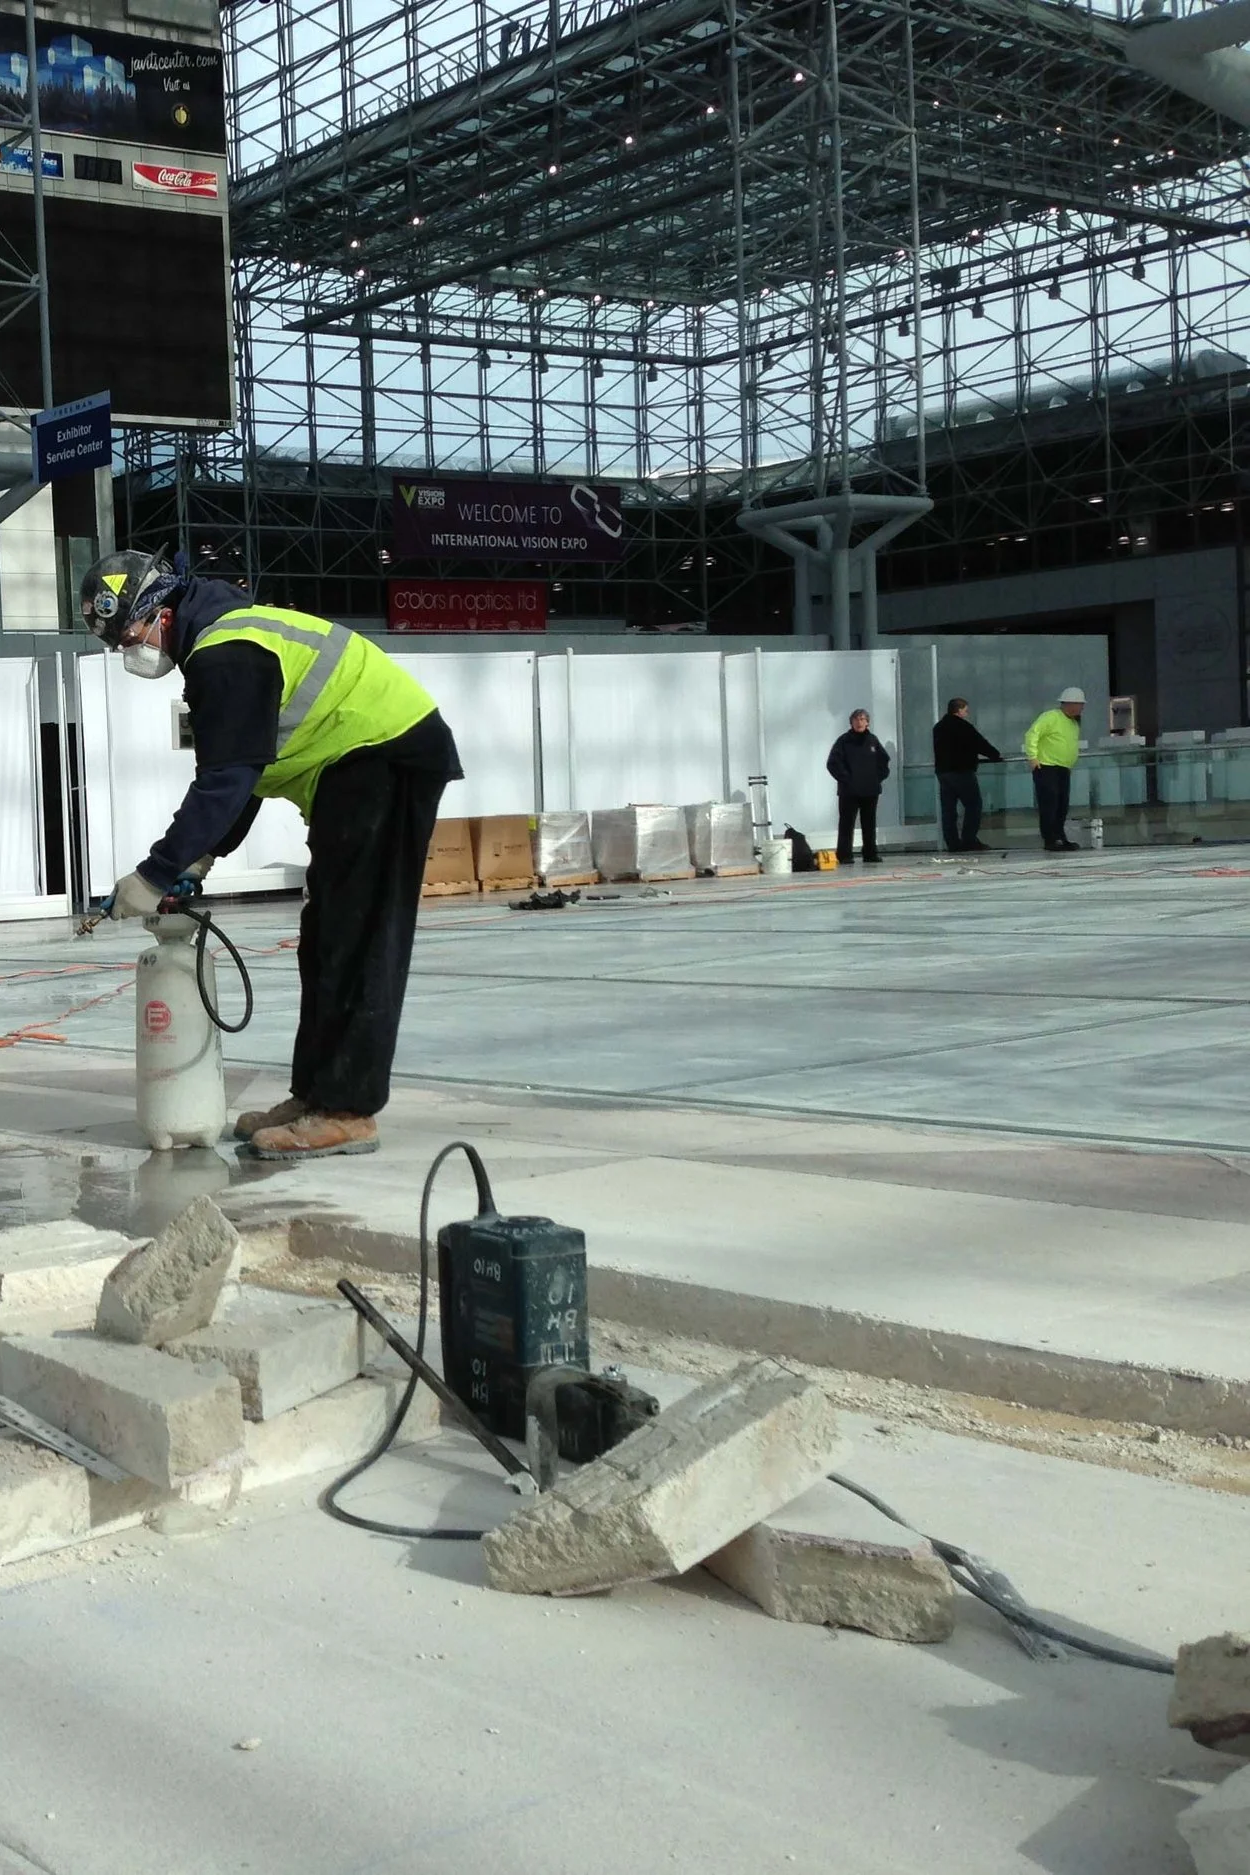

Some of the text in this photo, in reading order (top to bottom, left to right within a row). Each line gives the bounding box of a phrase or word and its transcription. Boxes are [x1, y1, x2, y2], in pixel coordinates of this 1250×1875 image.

[129, 51, 218, 77] javitscenter.com
[56, 424, 92, 442] Exhibitor
[46, 440, 104, 465] Service Center
[417, 497, 445, 506] EXPO
[457, 503, 562, 525] WELCOME TO
[431, 533, 588, 550] INTERNATIONAL VISION EXPO
